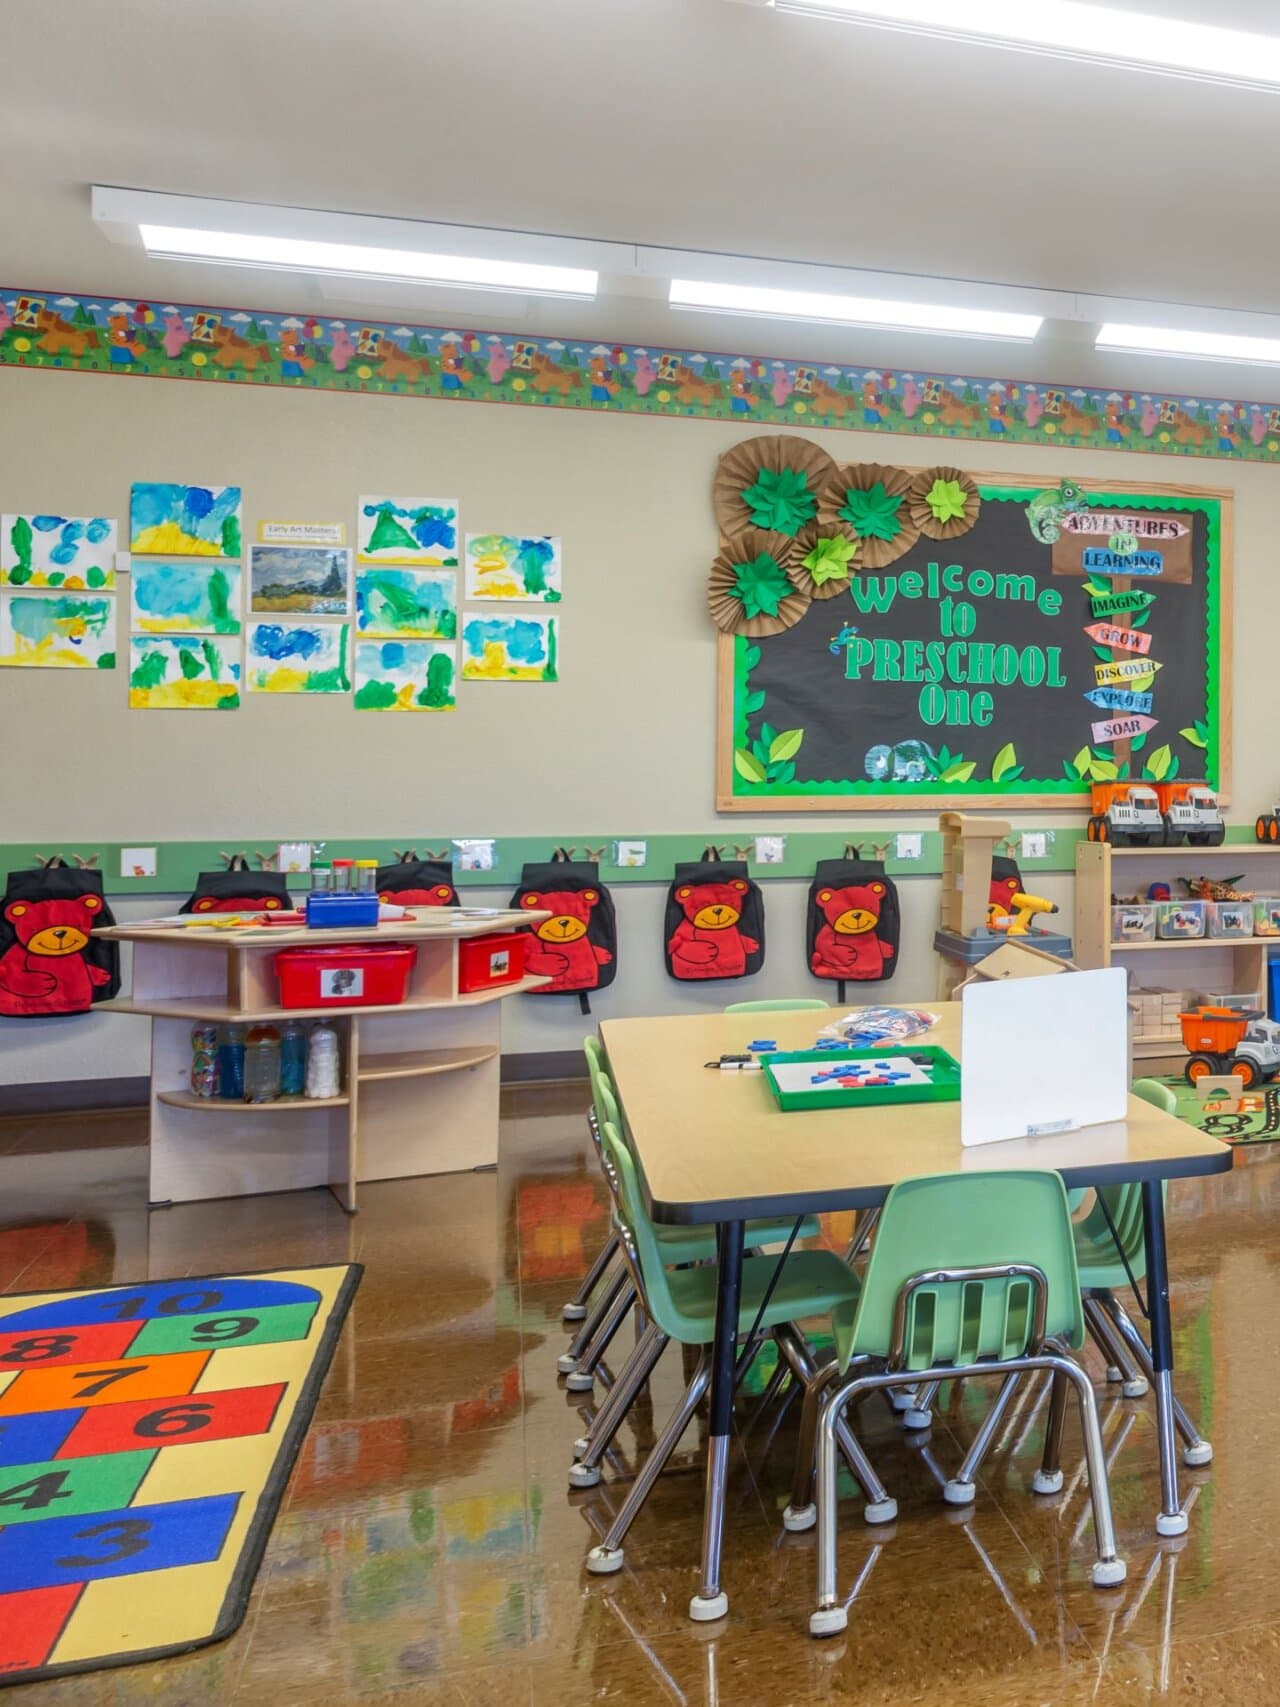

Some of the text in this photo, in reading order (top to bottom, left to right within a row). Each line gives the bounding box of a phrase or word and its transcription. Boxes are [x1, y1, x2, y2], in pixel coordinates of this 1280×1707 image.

[268, 525, 288, 534] Early
[1068, 515, 1178, 537] ADVENTURES
[1115, 538, 1131, 550] IN
[1084, 552, 1160, 569] LEARNING
[851, 563, 1063, 616] Welcome
[1094, 592, 1147, 612] IMAGINE
[939, 596, 977, 638] to
[1100, 628, 1142, 648] GROW
[845, 638, 1067, 687] PRESCHOOL
[1096, 661, 1157, 681] DISCOVER
[919, 683, 994, 727] One
[1093, 691, 1151, 708] EXPLORE
[1103, 720, 1141, 737] SOAR
[100, 1290, 224, 1319] 10
[190, 1316, 260, 1342] 9
[0, 1334, 79, 1363] 8
[71, 1365, 149, 1398] 7
[133, 1403, 216, 1438] 6
[0, 1470, 74, 1510] 4
[55, 1518, 153, 1568] 3
